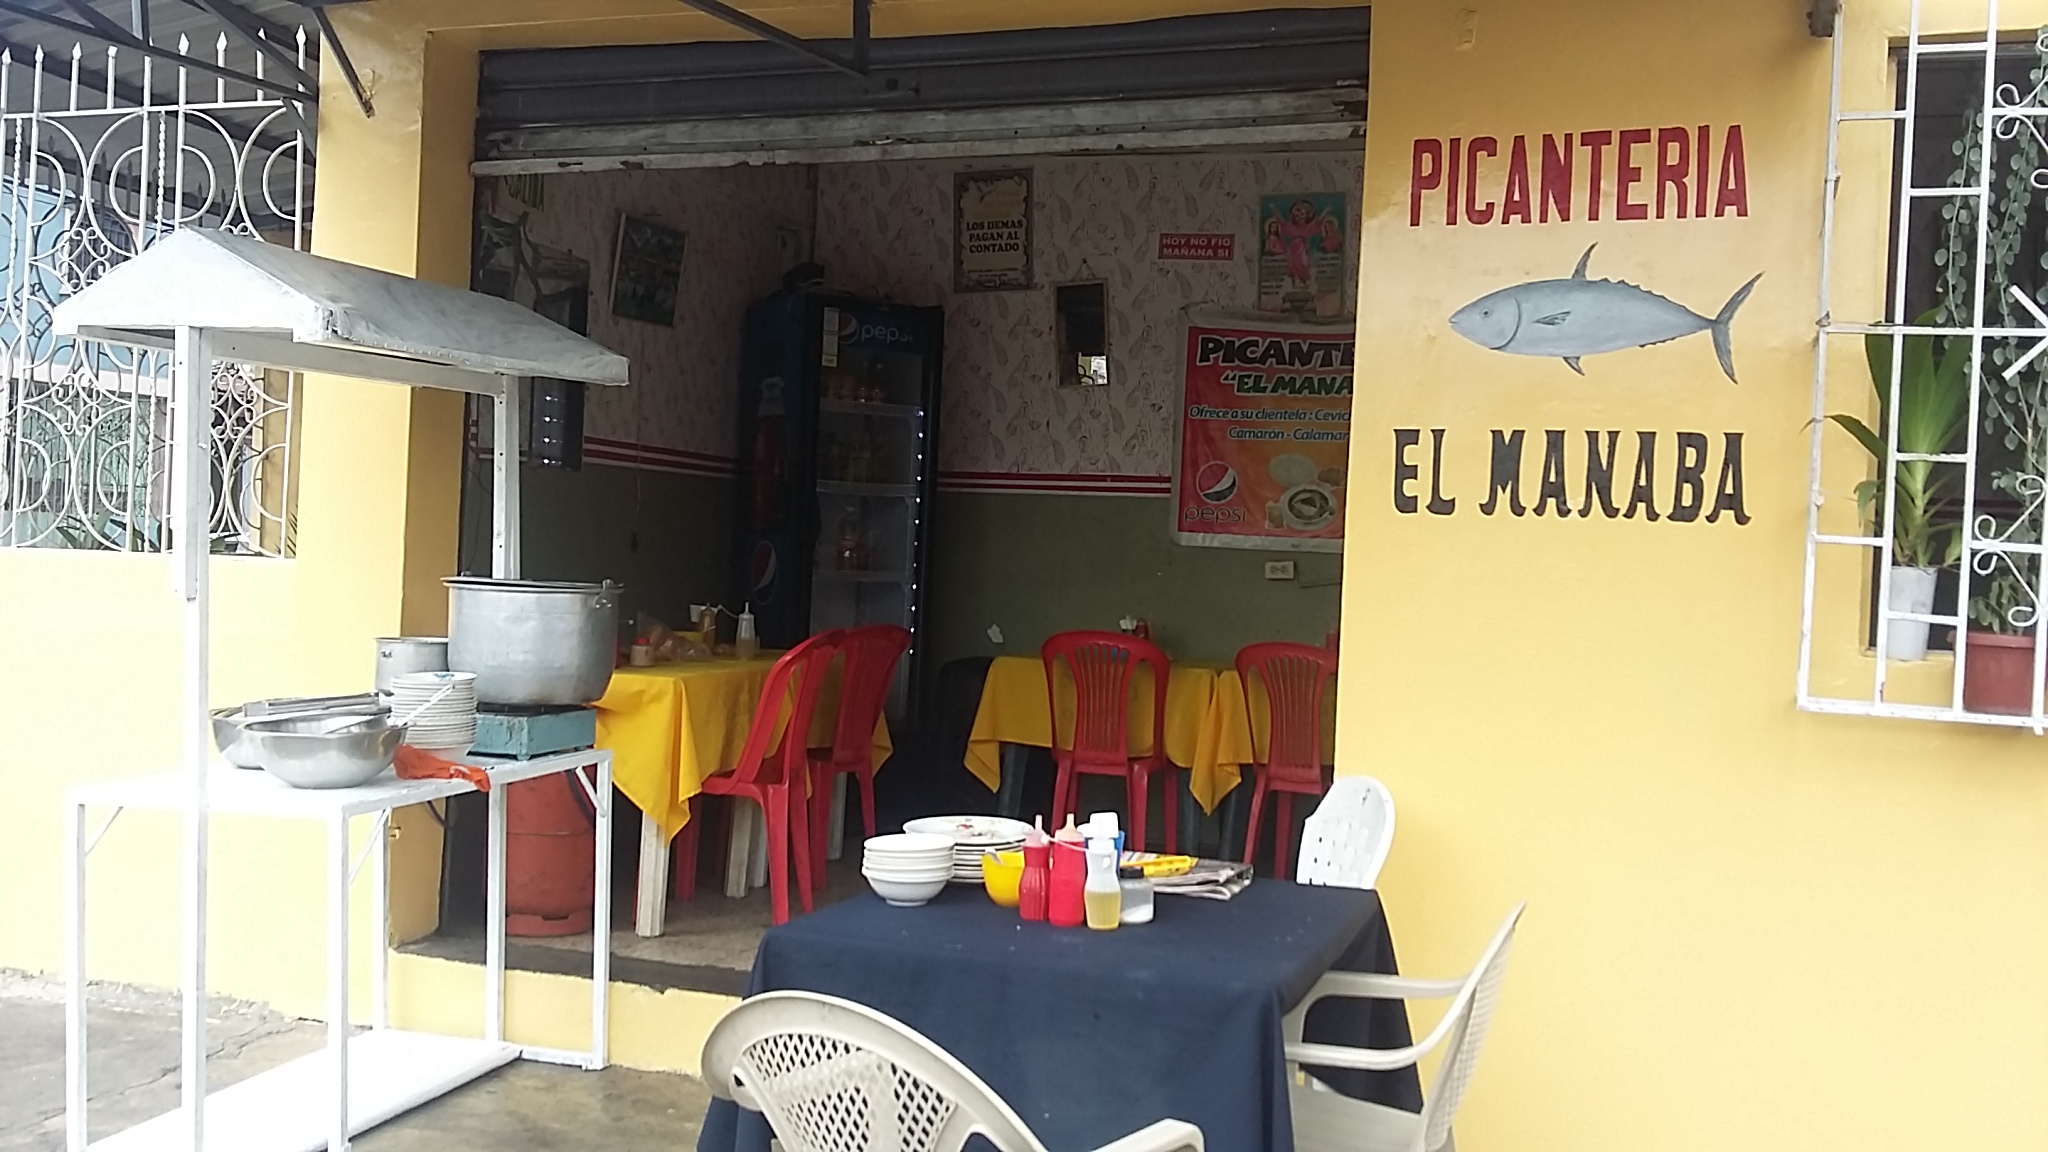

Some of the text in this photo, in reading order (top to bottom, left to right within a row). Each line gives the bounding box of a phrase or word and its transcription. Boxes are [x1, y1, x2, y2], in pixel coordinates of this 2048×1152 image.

[1409, 124, 1749, 227] PICANTERIA
[966, 219, 1023, 231] LOS DEMAS
[969, 230, 1020, 243] PAGAN AL
[1162, 236, 1231, 247] HOY NO FIO
[969, 242, 1020, 254] CONTADO
[1162, 247, 1214, 257] MAÑANA
[1189, 405, 1230, 420] Ofrece
[1231, 409, 1239, 419] a
[1240, 410, 1253, 419] su
[1254, 407, 1307, 421] clientela
[1314, 408, 1351, 421] Cevic
[1228, 426, 1285, 440] Camarón
[1392, 428, 1752, 526] EL MANABA
[1184, 505, 1247, 523] pepsi
